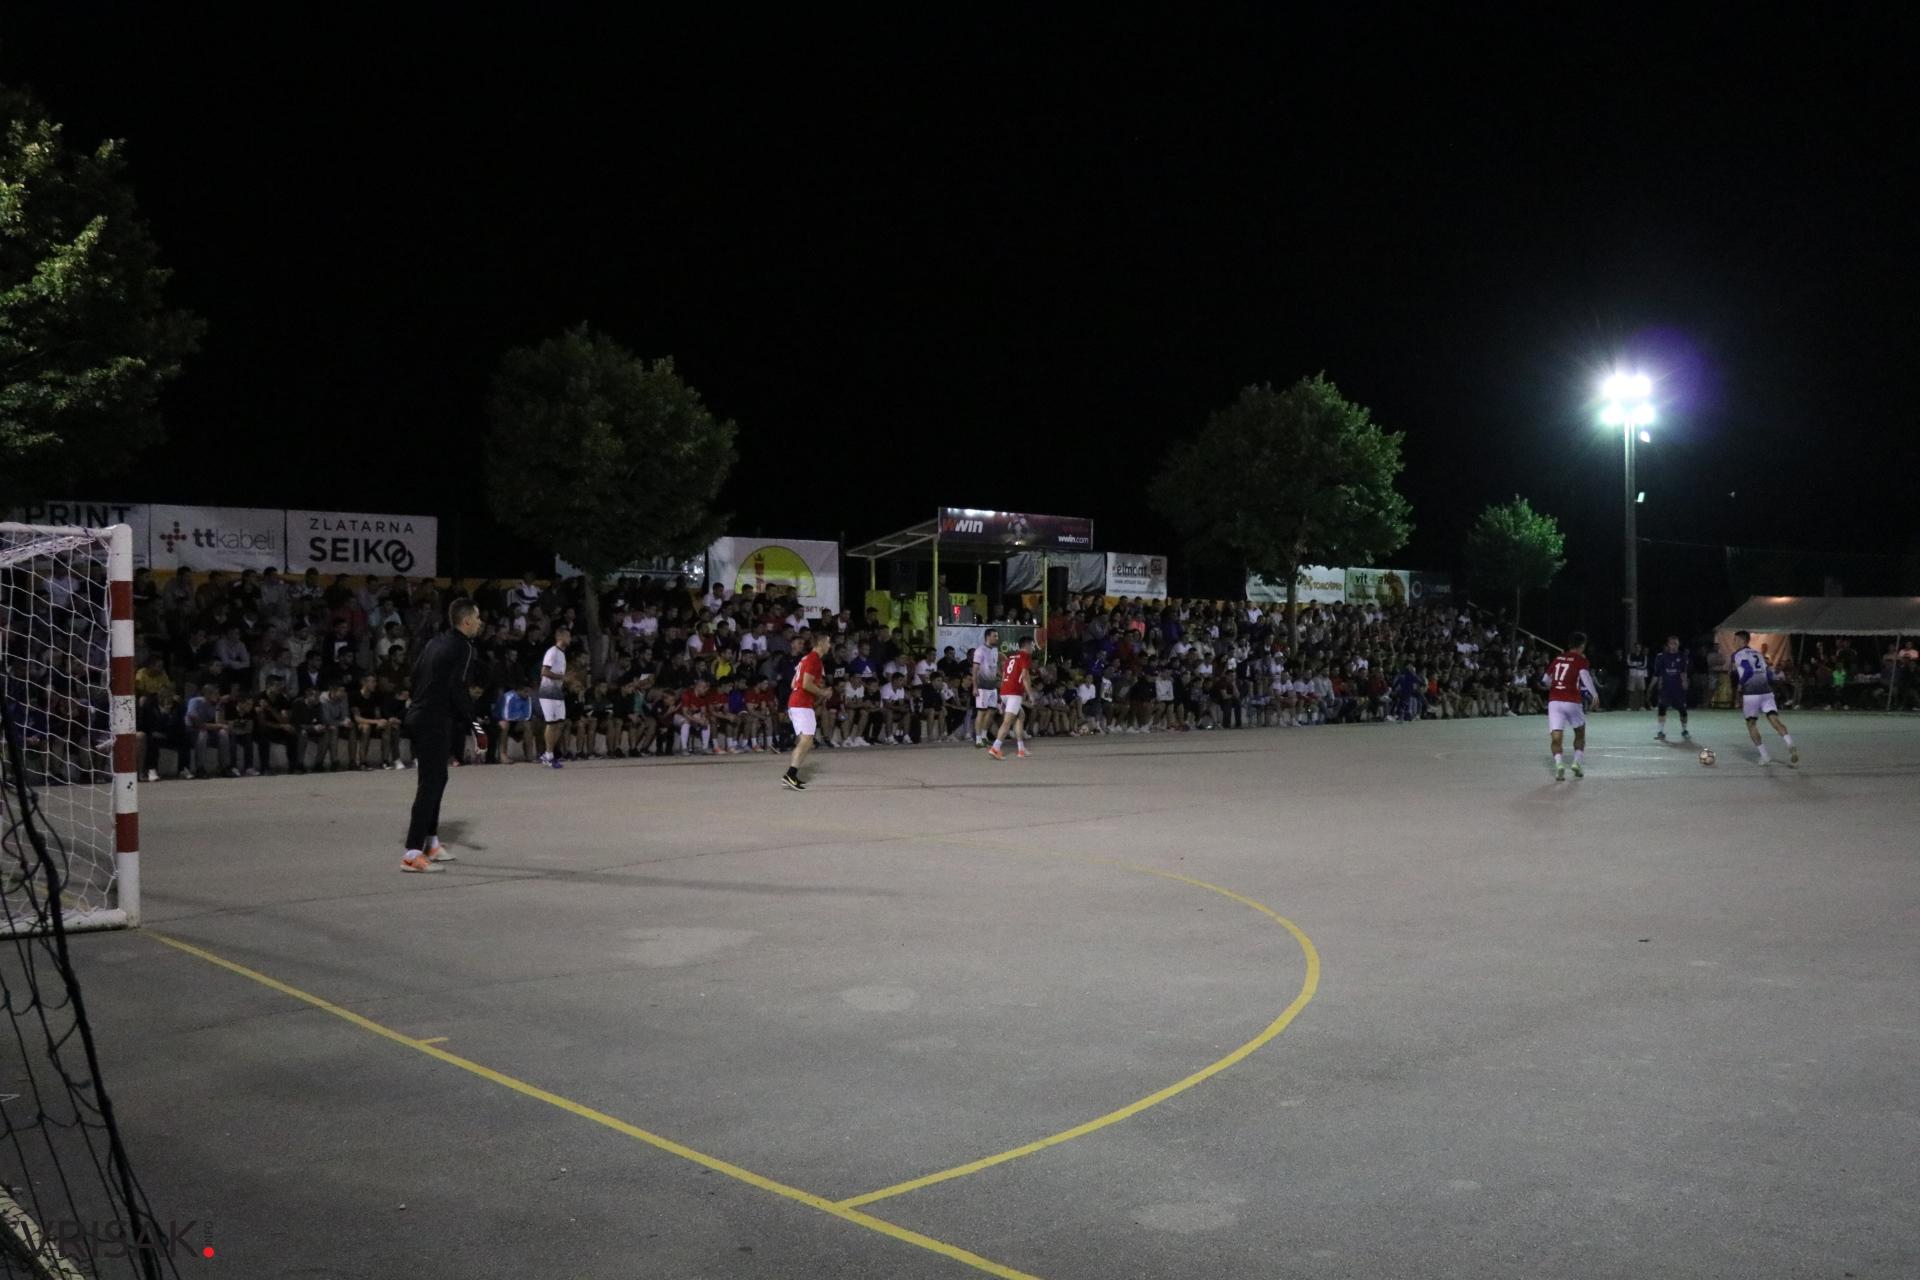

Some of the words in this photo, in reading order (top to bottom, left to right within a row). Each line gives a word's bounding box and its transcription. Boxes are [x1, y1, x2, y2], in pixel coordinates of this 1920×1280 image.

[310, 518, 414, 534] ZLATARNA
[193, 528, 275, 550] ttkabeli
[1058, 534, 1089, 544] wwin.com
[1006, 659, 1016, 674] 8
[1753, 655, 1761, 668] 2
[1554, 662, 1570, 681] 17
